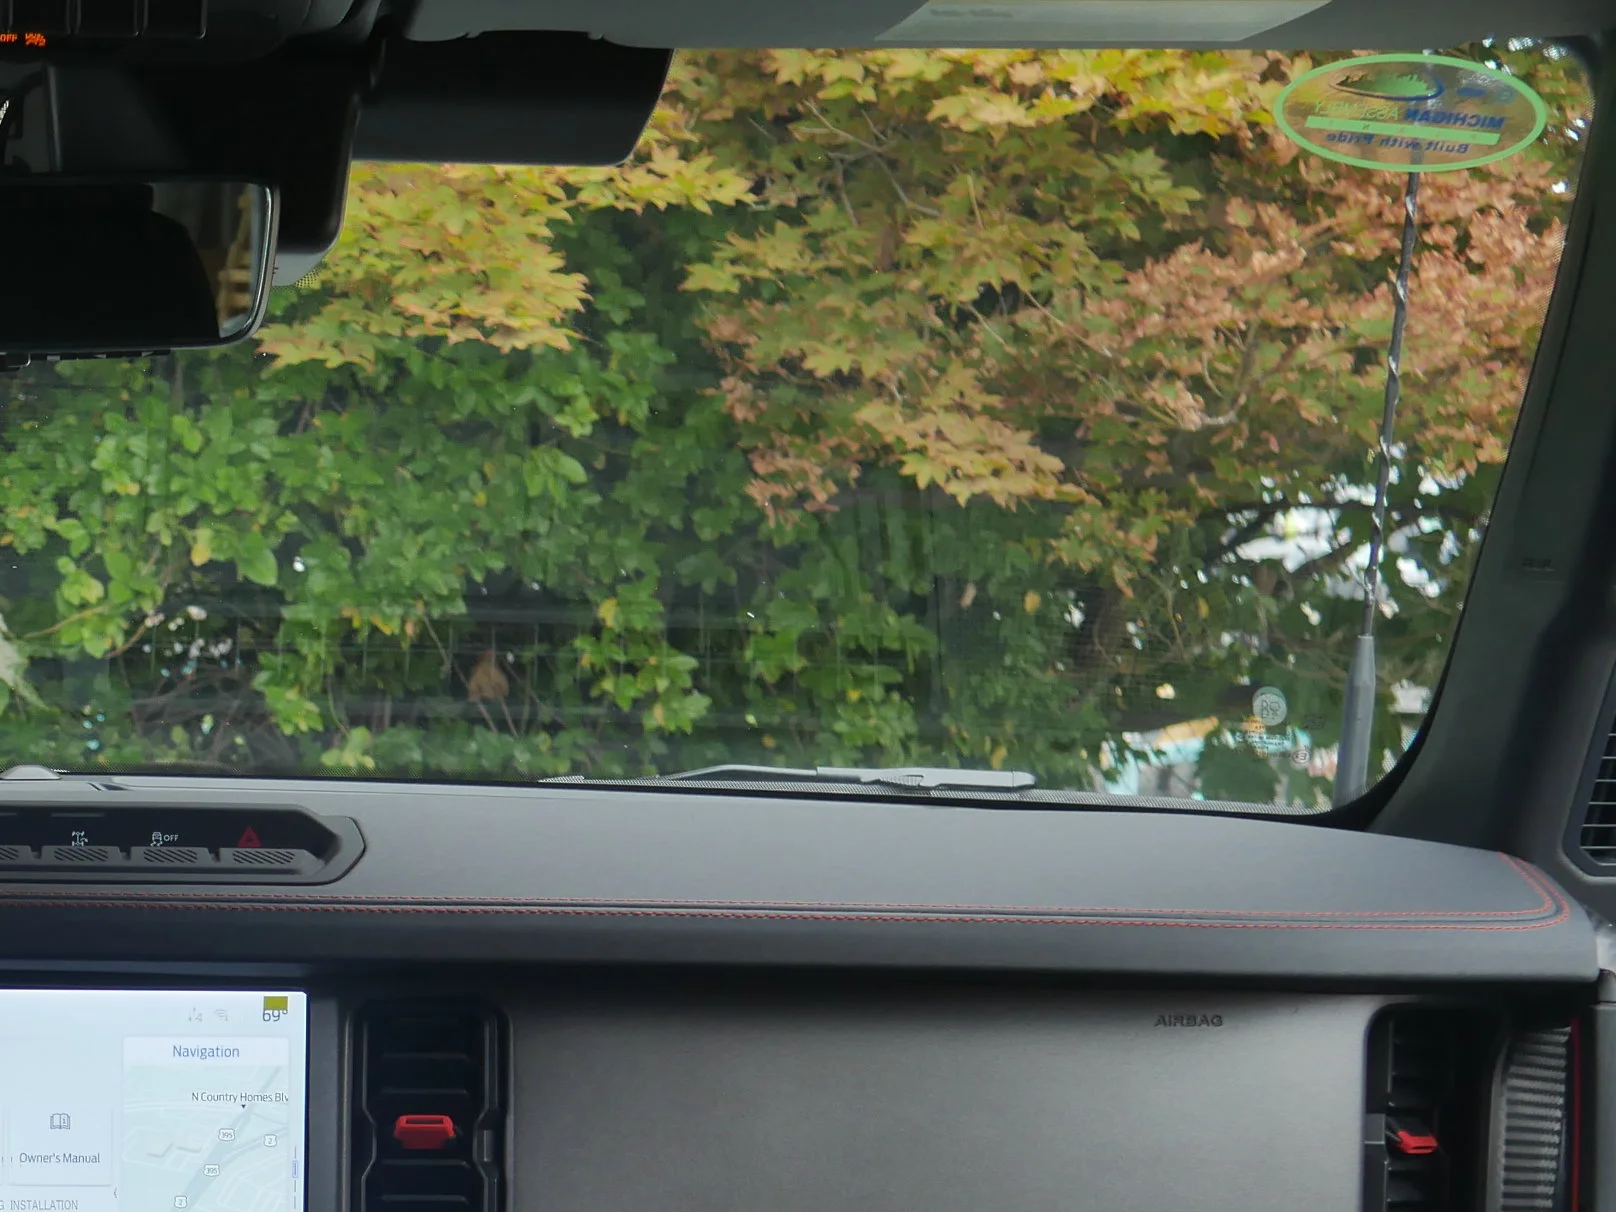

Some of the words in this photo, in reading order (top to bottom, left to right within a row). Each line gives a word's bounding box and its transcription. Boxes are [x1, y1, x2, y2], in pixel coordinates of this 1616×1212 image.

[163, 834, 178, 842] OFF
[1153, 1013, 1224, 1028] AIRBAG
[172, 1044, 240, 1060] Navigation
[191, 1092, 199, 1102] N
[200, 1092, 238, 1104] Country
[240, 1092, 273, 1102] Homes
[19, 1152, 61, 1164] Owner's
[62, 1152, 101, 1164] Manual
[10, 1200, 79, 1211] INSTALLATION
